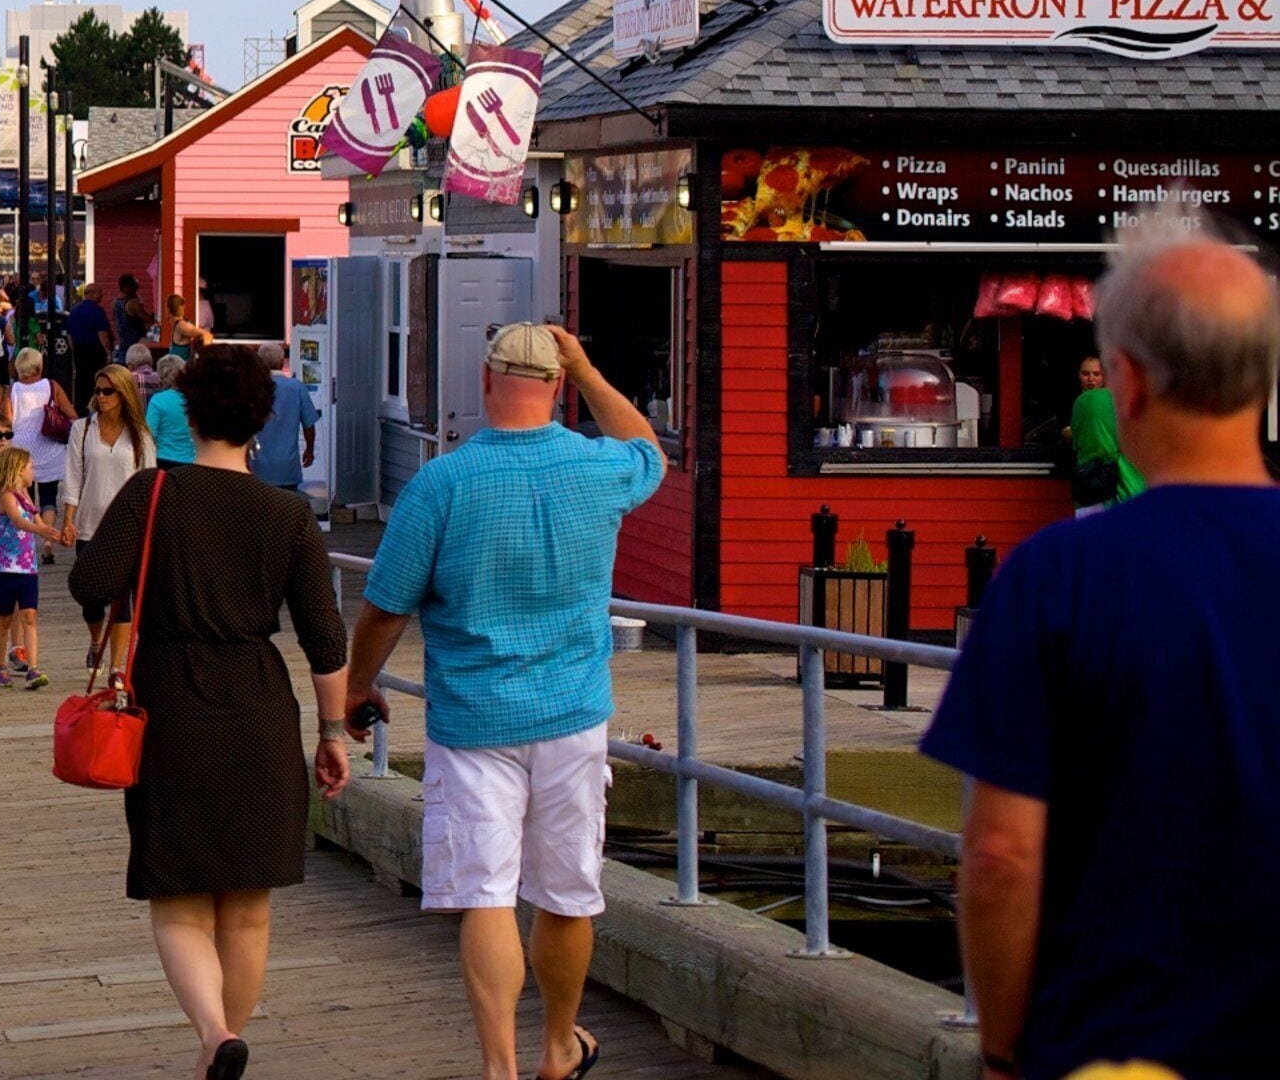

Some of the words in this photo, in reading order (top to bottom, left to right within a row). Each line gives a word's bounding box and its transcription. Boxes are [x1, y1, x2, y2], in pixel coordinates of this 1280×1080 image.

[896, 155, 947, 174] Pizza
[1004, 157, 1066, 175] Panini
[1112, 158, 1220, 179] Quesadillas
[896, 182, 959, 206] Wraps
[1004, 183, 1073, 202] Nachos
[896, 208, 971, 227] Donairs
[1004, 209, 1066, 228] Salads
